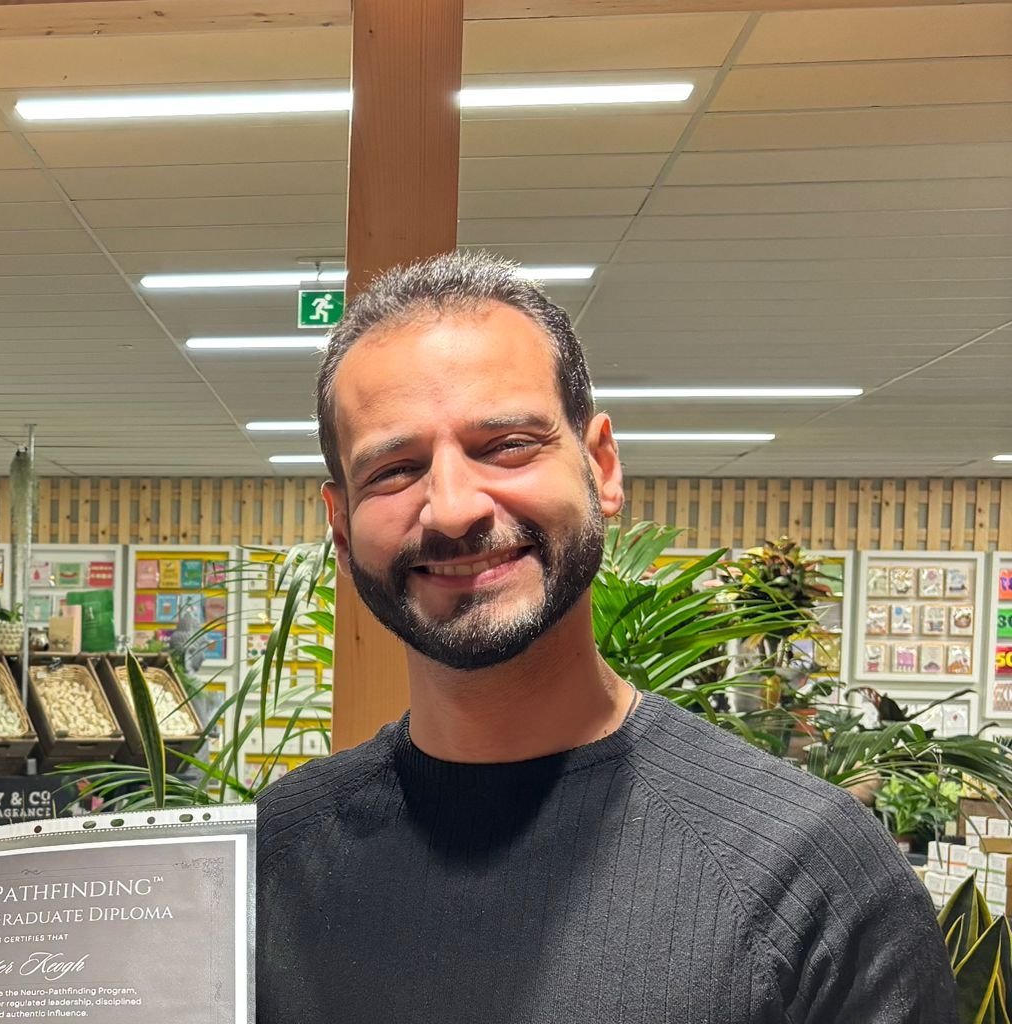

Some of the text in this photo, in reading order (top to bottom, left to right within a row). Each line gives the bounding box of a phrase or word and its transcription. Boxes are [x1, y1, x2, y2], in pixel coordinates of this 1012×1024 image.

[10, 790, 23, 806] &
[89, 906, 173, 922] DIPLOMA
[4, 934, 45, 943] CERTIFIES
[47, 933, 68, 941] THAT
[19, 951, 91, 981] Keogh
[5, 989, 19, 997] the
[20, 987, 97, 996] Neuro-Pathfinding
[98, 987, 137, 996] Program,
[6, 999, 46, 1009] regulated
[48, 998, 94, 1007] leadership,
[95, 997, 142, 1007] disciplined
[6, 1010, 46, 1018] authentic
[47, 1009, 89, 1017] influence.
